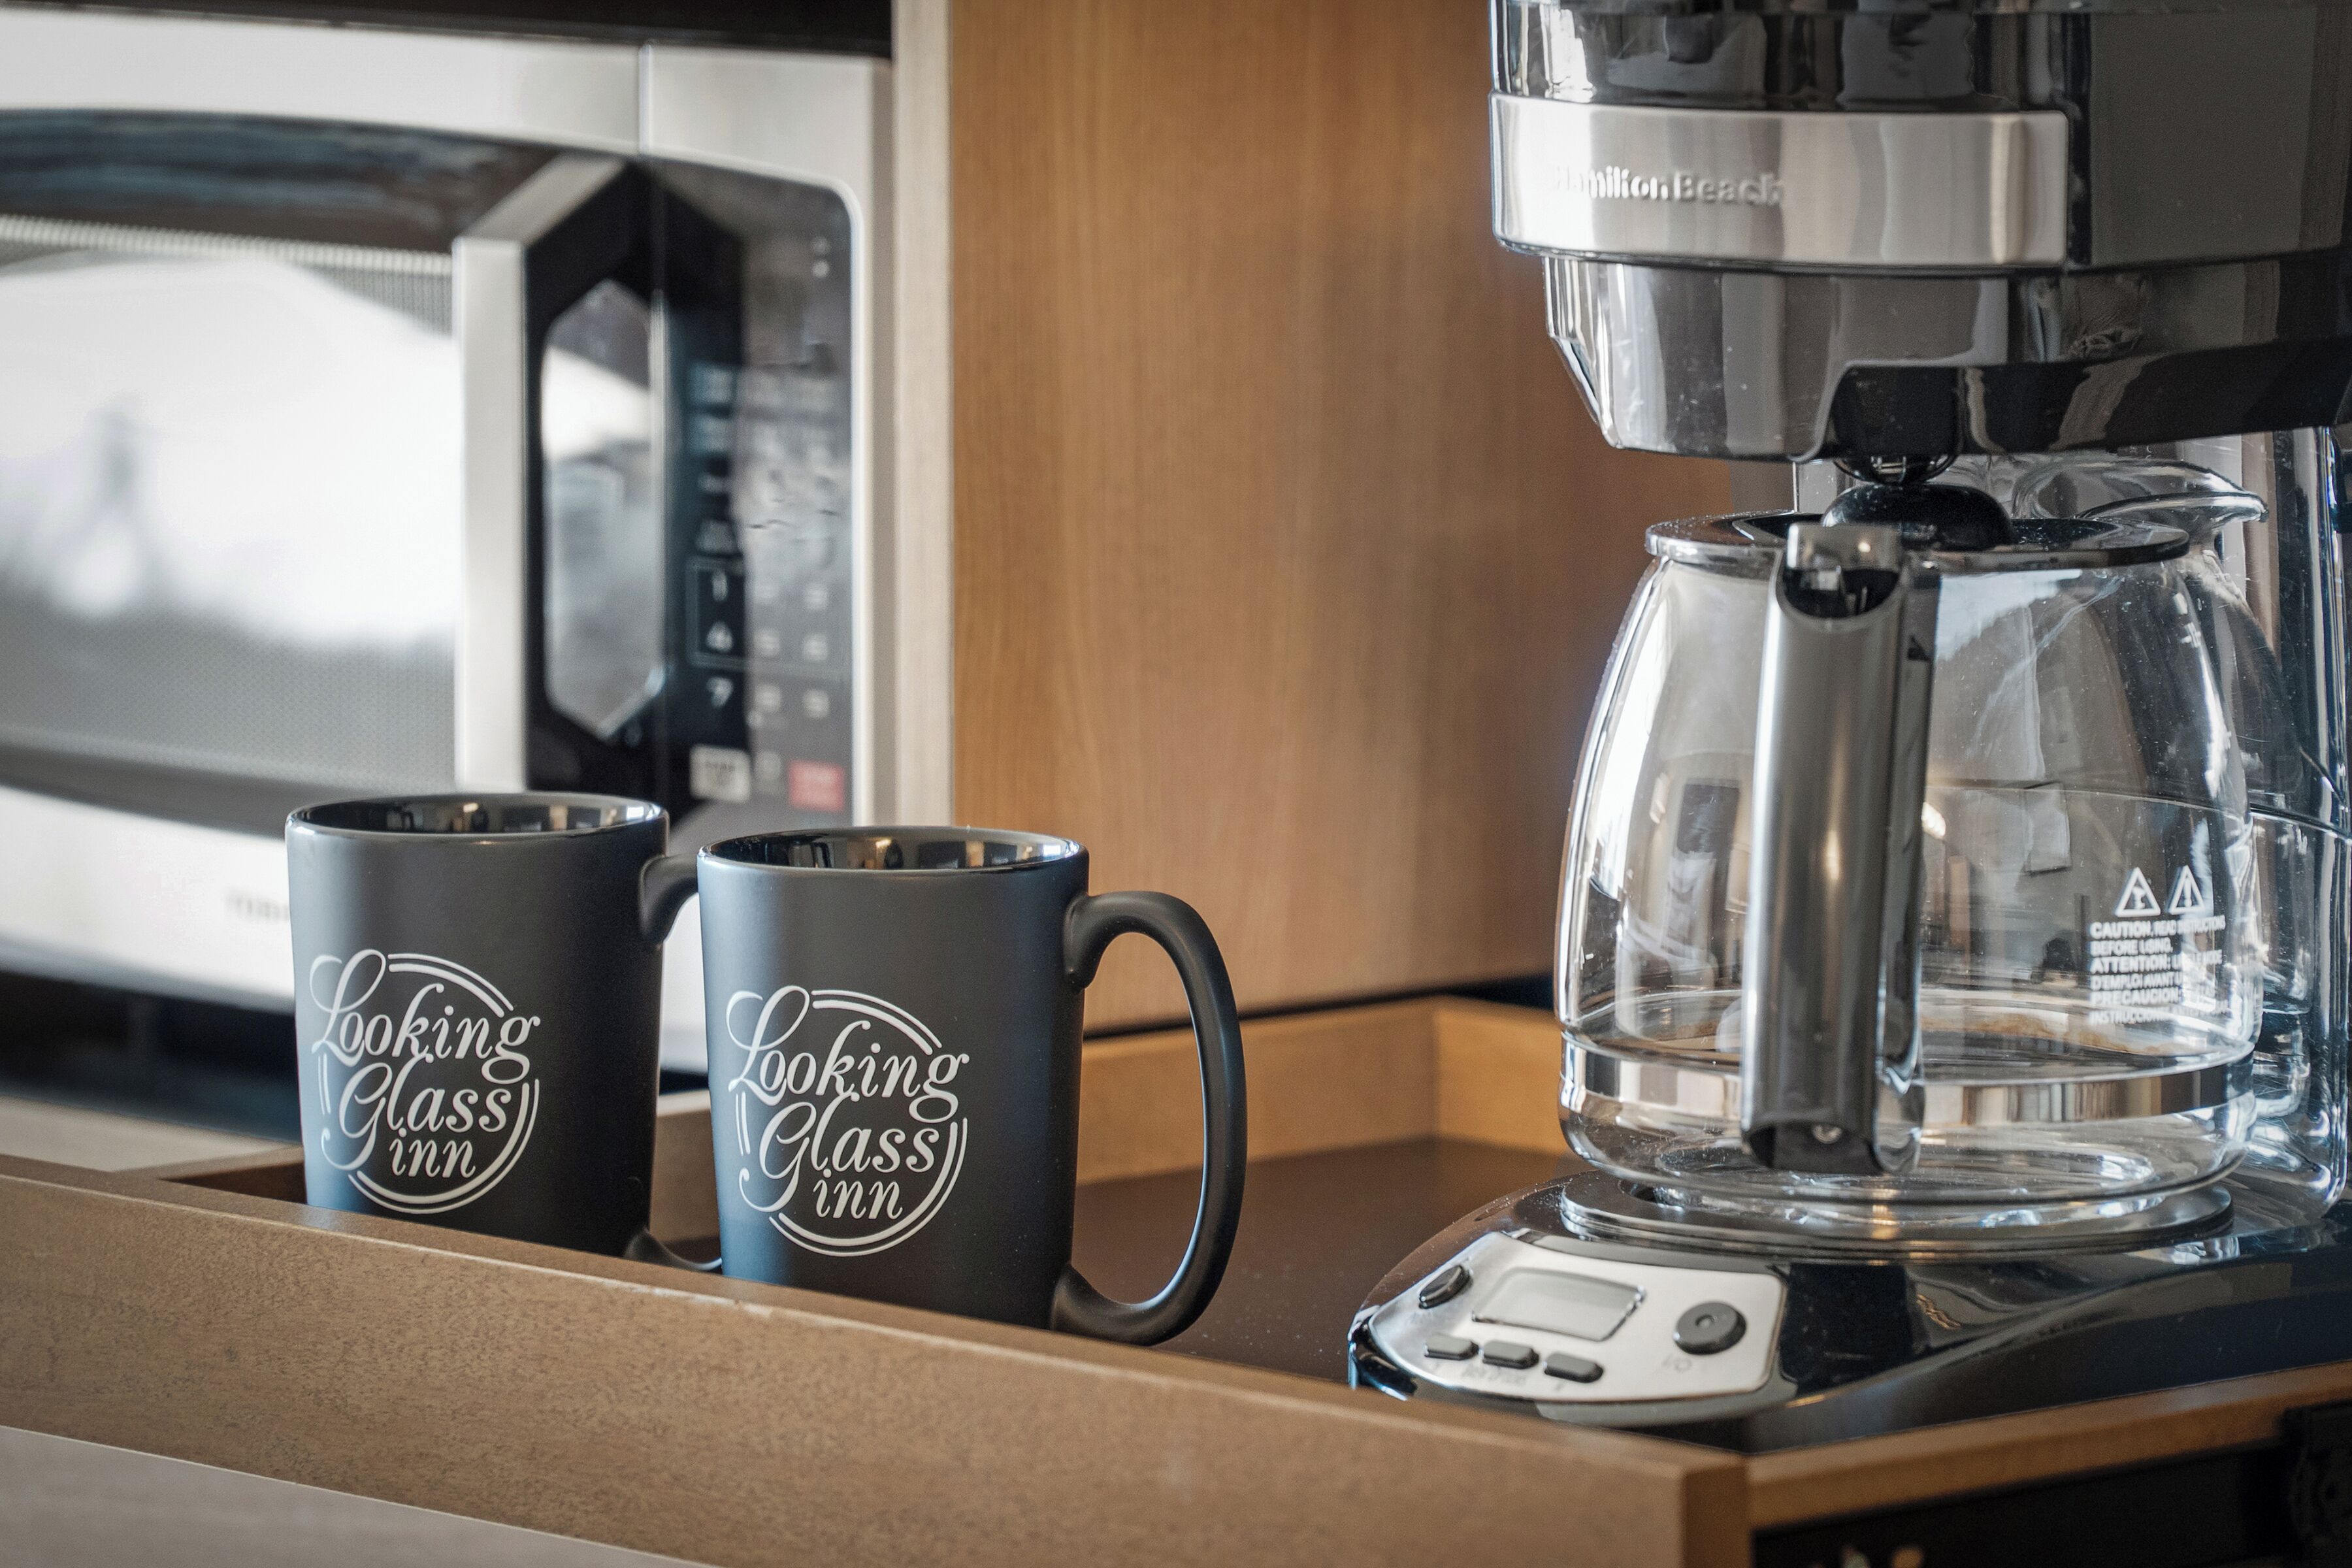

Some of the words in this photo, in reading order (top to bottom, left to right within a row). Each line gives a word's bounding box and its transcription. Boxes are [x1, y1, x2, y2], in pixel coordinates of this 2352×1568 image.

[2090, 954, 2170, 973] ATTENTION:
[2091, 939, 2138, 956] BEFORE
[310, 949, 541, 1085] Looking
[726, 985, 970, 1124] Looking
[321, 1053, 512, 1171] Glass
[389, 1127, 476, 1178] inn
[738, 1090, 939, 1213] Glass
[813, 1168, 904, 1220] inn
